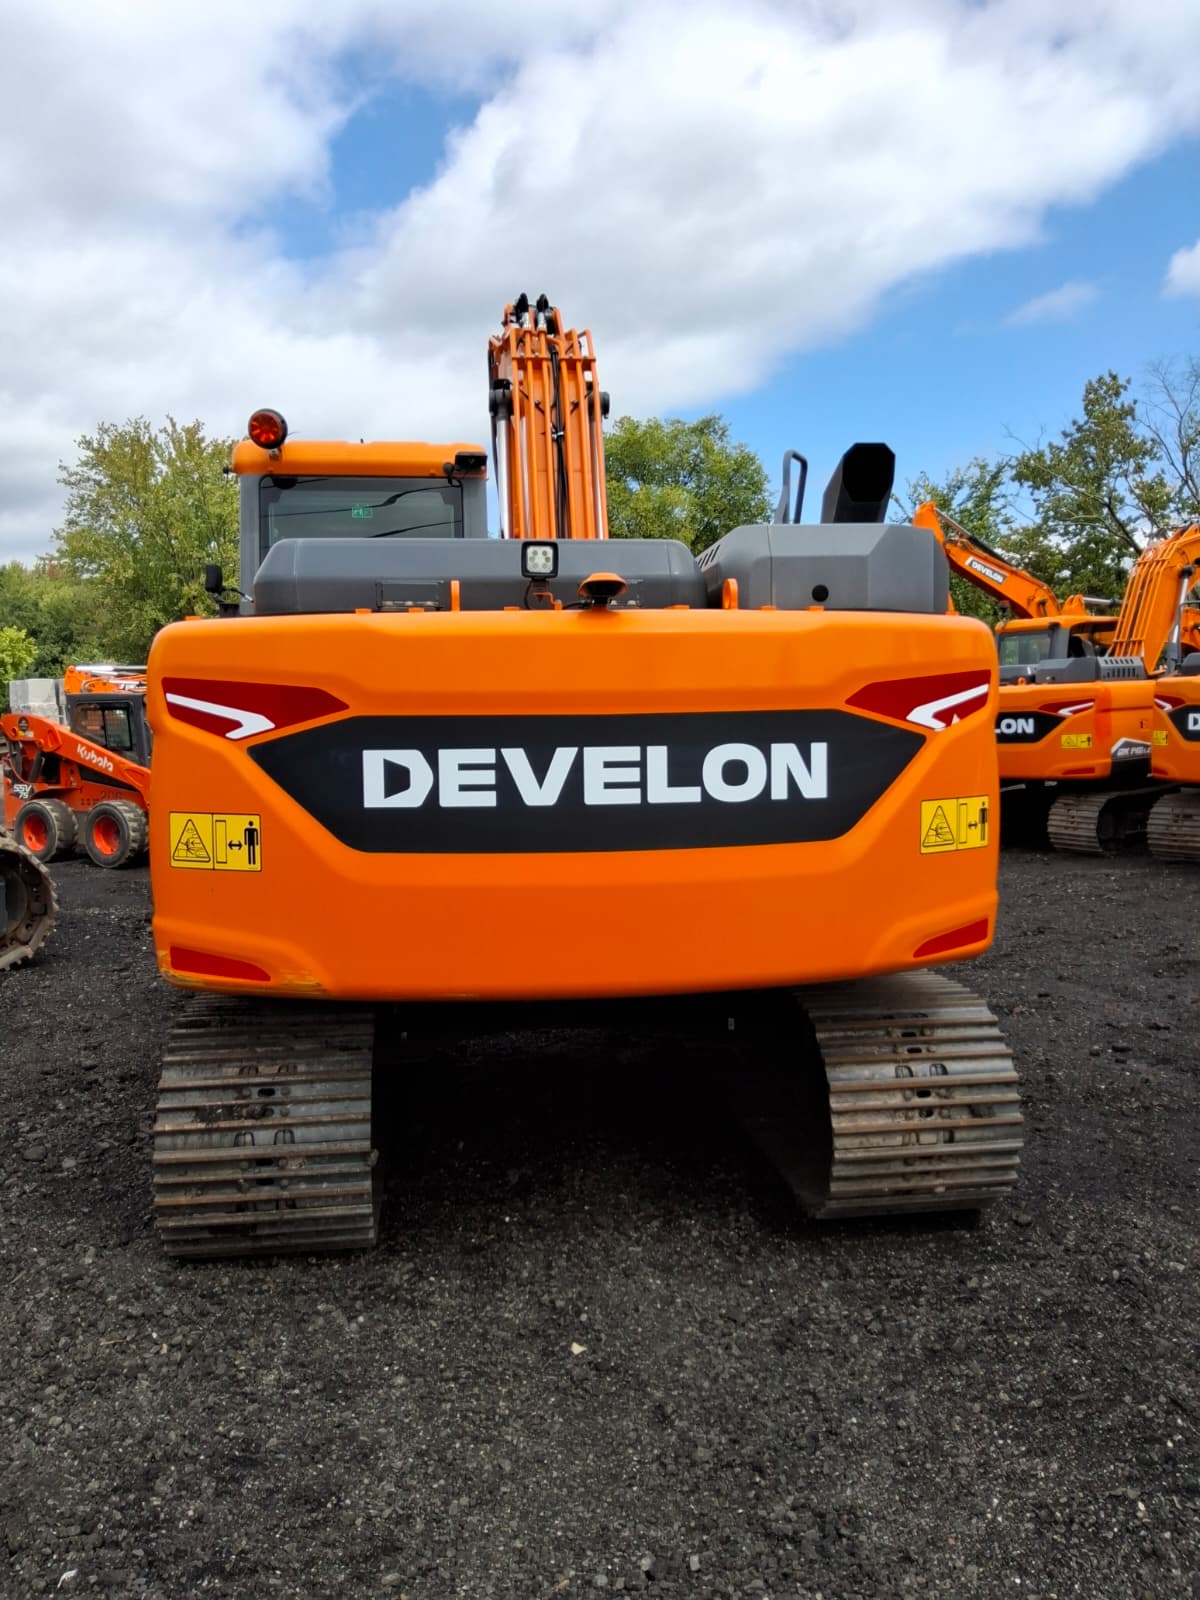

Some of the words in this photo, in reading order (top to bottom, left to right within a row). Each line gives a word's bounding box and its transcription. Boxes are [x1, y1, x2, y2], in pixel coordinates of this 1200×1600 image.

[995, 718, 1034, 734] ON
[77, 743, 113, 772] Kubota
[362, 741, 828, 808] DEVELON
